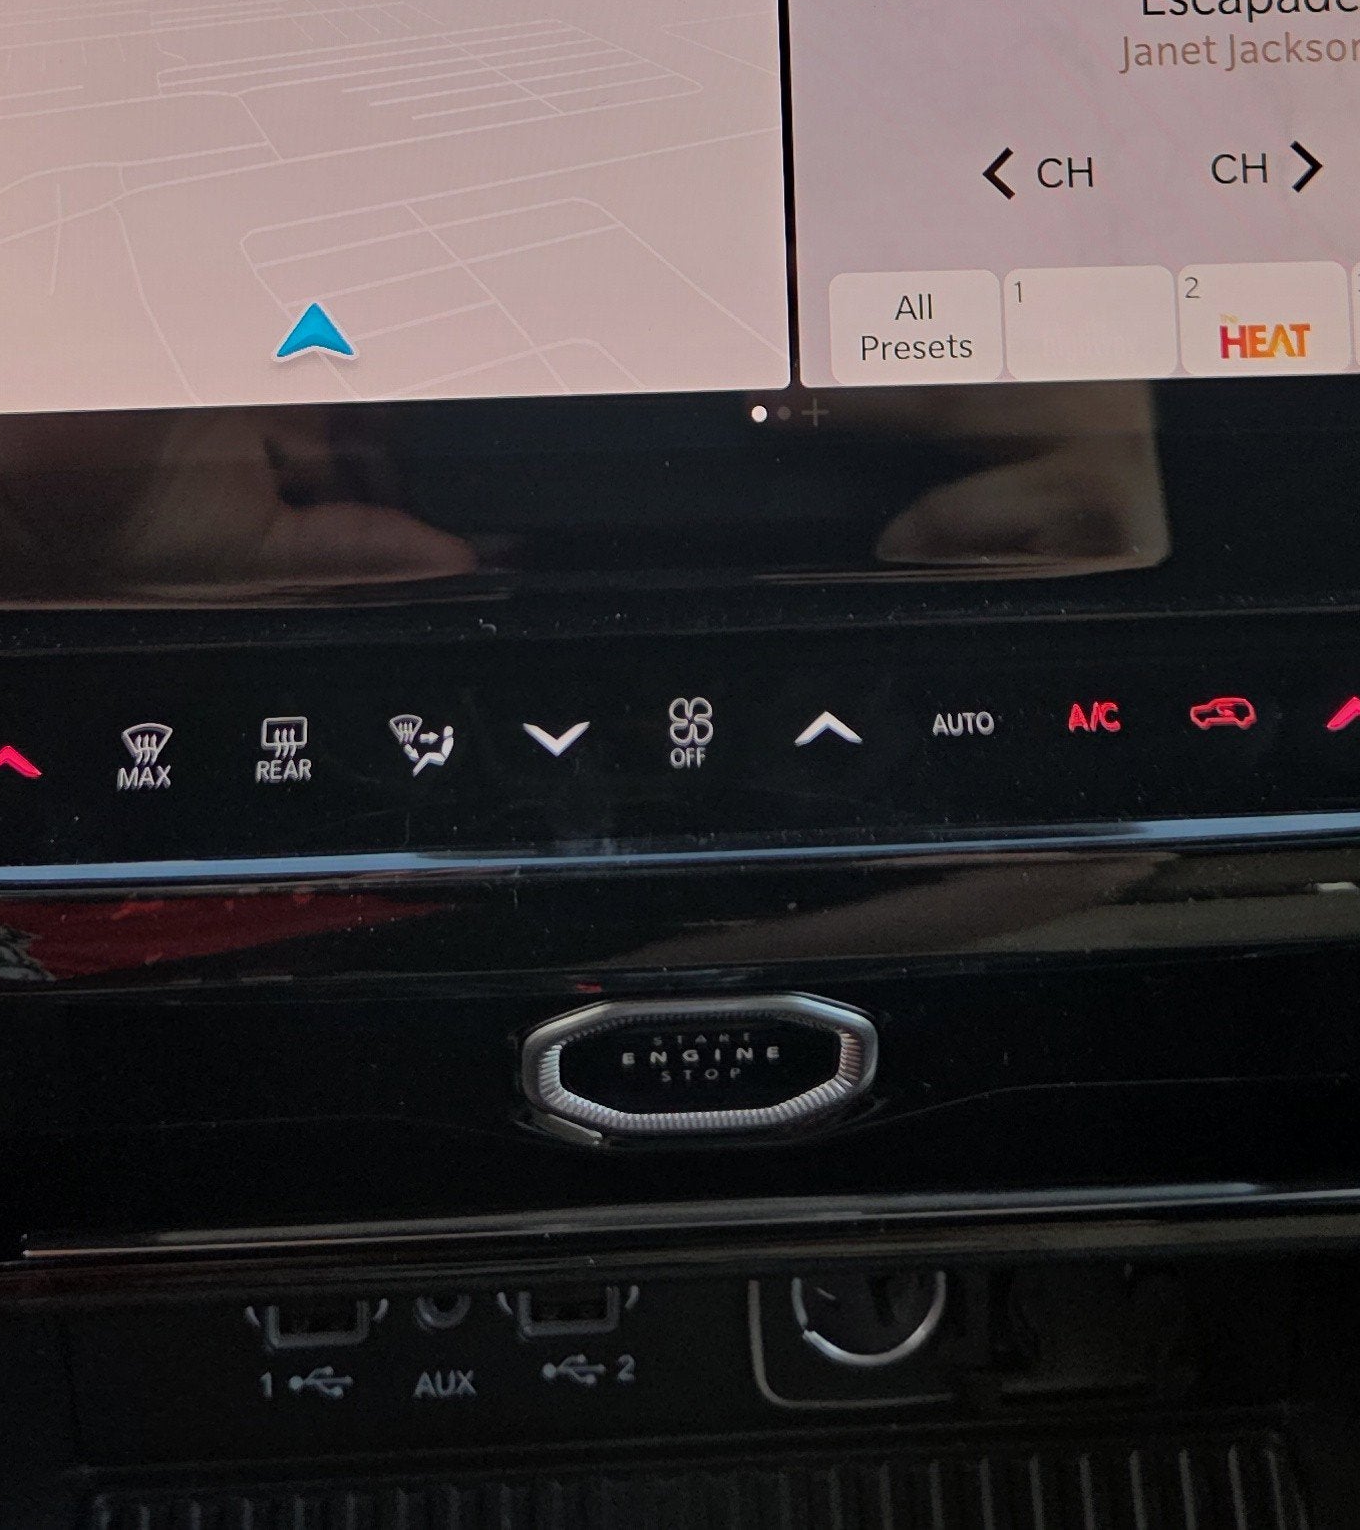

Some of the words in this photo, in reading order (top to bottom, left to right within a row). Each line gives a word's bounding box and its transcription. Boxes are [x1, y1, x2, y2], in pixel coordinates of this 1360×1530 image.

[1119, 34, 1218, 73] Janet
[1037, 157, 1094, 189] CH
[1211, 153, 1269, 185] CH
[1013, 281, 1025, 304] 1
[1184, 276, 1201, 300] 2
[895, 294, 935, 322] All
[860, 332, 974, 362] Presets
[1219, 323, 1311, 358] HEAT
[933, 712, 995, 737] AUTO
[1068, 702, 1121, 734] A/C
[669, 747, 706, 769] OFF
[117, 766, 171, 790] MAX
[256, 759, 312, 783] REAR
[621, 1046, 780, 1066] ENGINE
[661, 1069, 741, 1083] STOP
[618, 1356, 636, 1382] 2
[260, 1374, 273, 1397] 1
[414, 1371, 477, 1398] AUX
